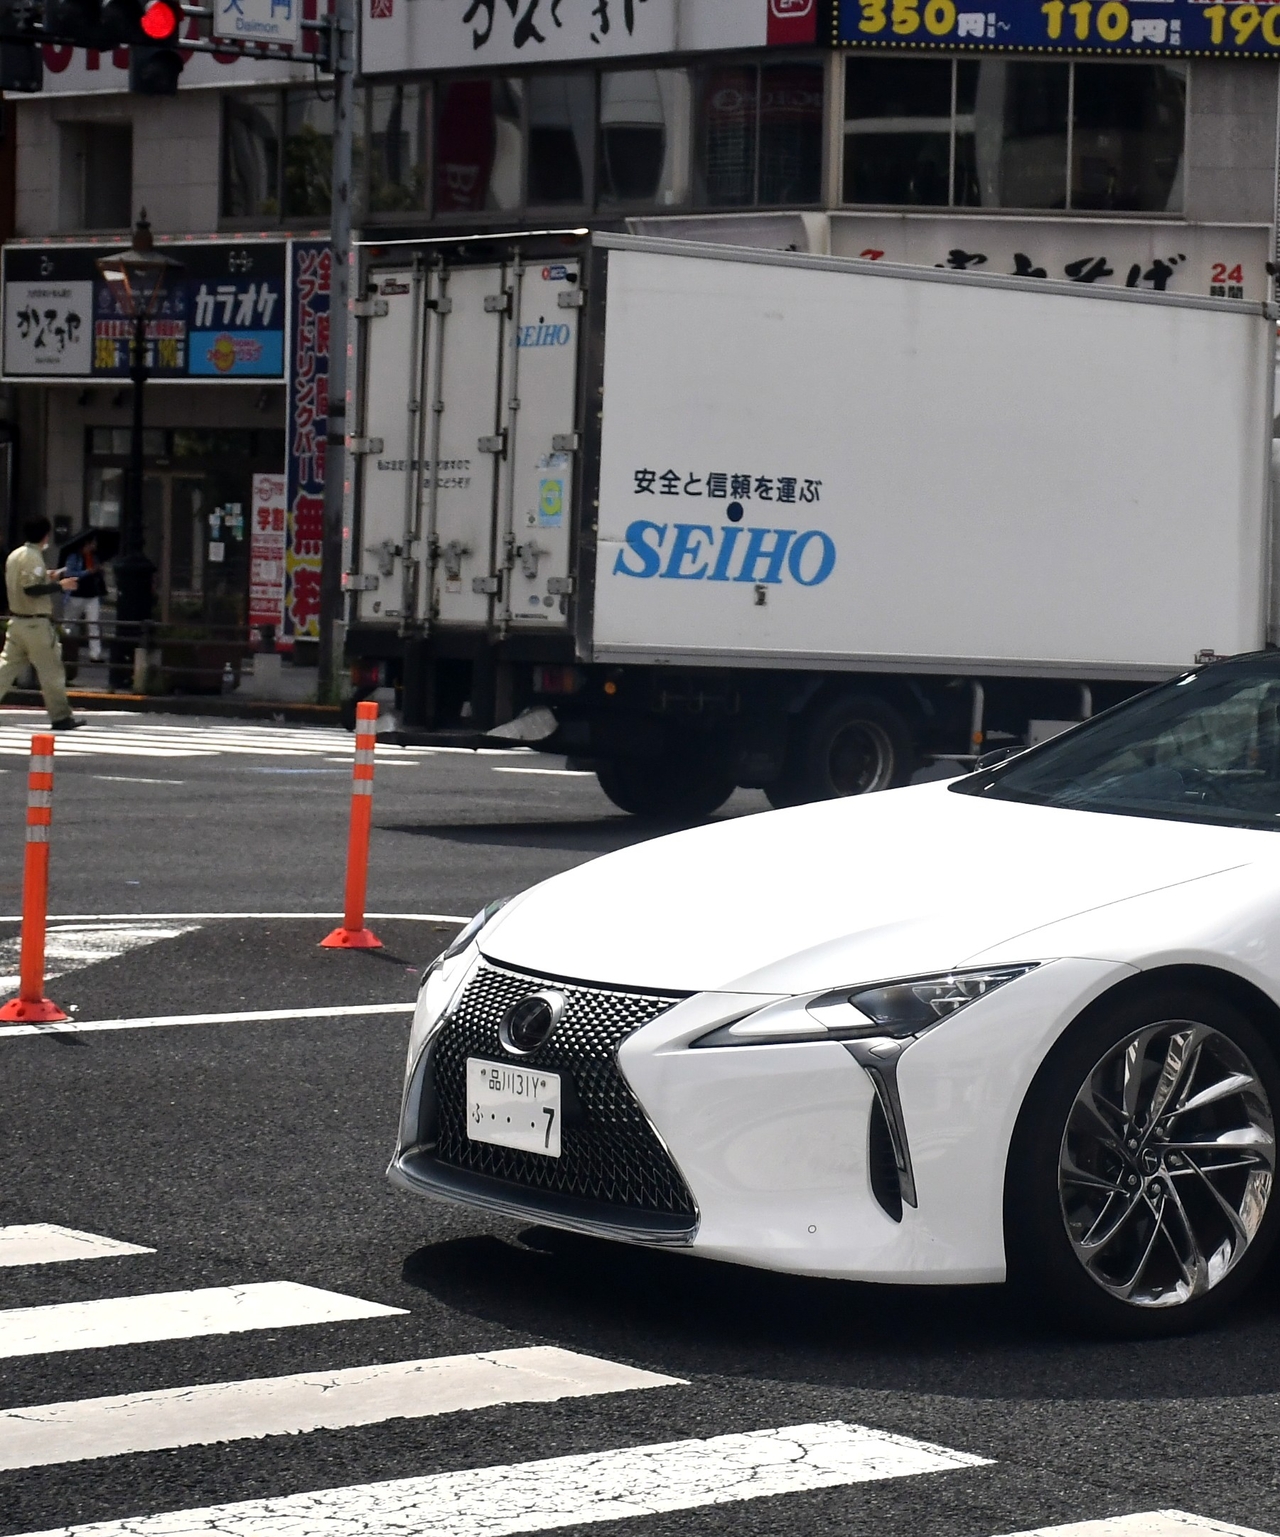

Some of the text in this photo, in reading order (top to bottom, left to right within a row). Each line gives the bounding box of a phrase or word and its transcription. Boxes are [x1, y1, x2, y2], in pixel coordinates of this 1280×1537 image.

[235, 16, 279, 33] Daimon
[1211, 262, 1244, 284] 24
[194, 281, 279, 328] カラオケ
[633, 468, 823, 503] 安全と信頼を運ぶ
[612, 519, 837, 587] SEIHO
